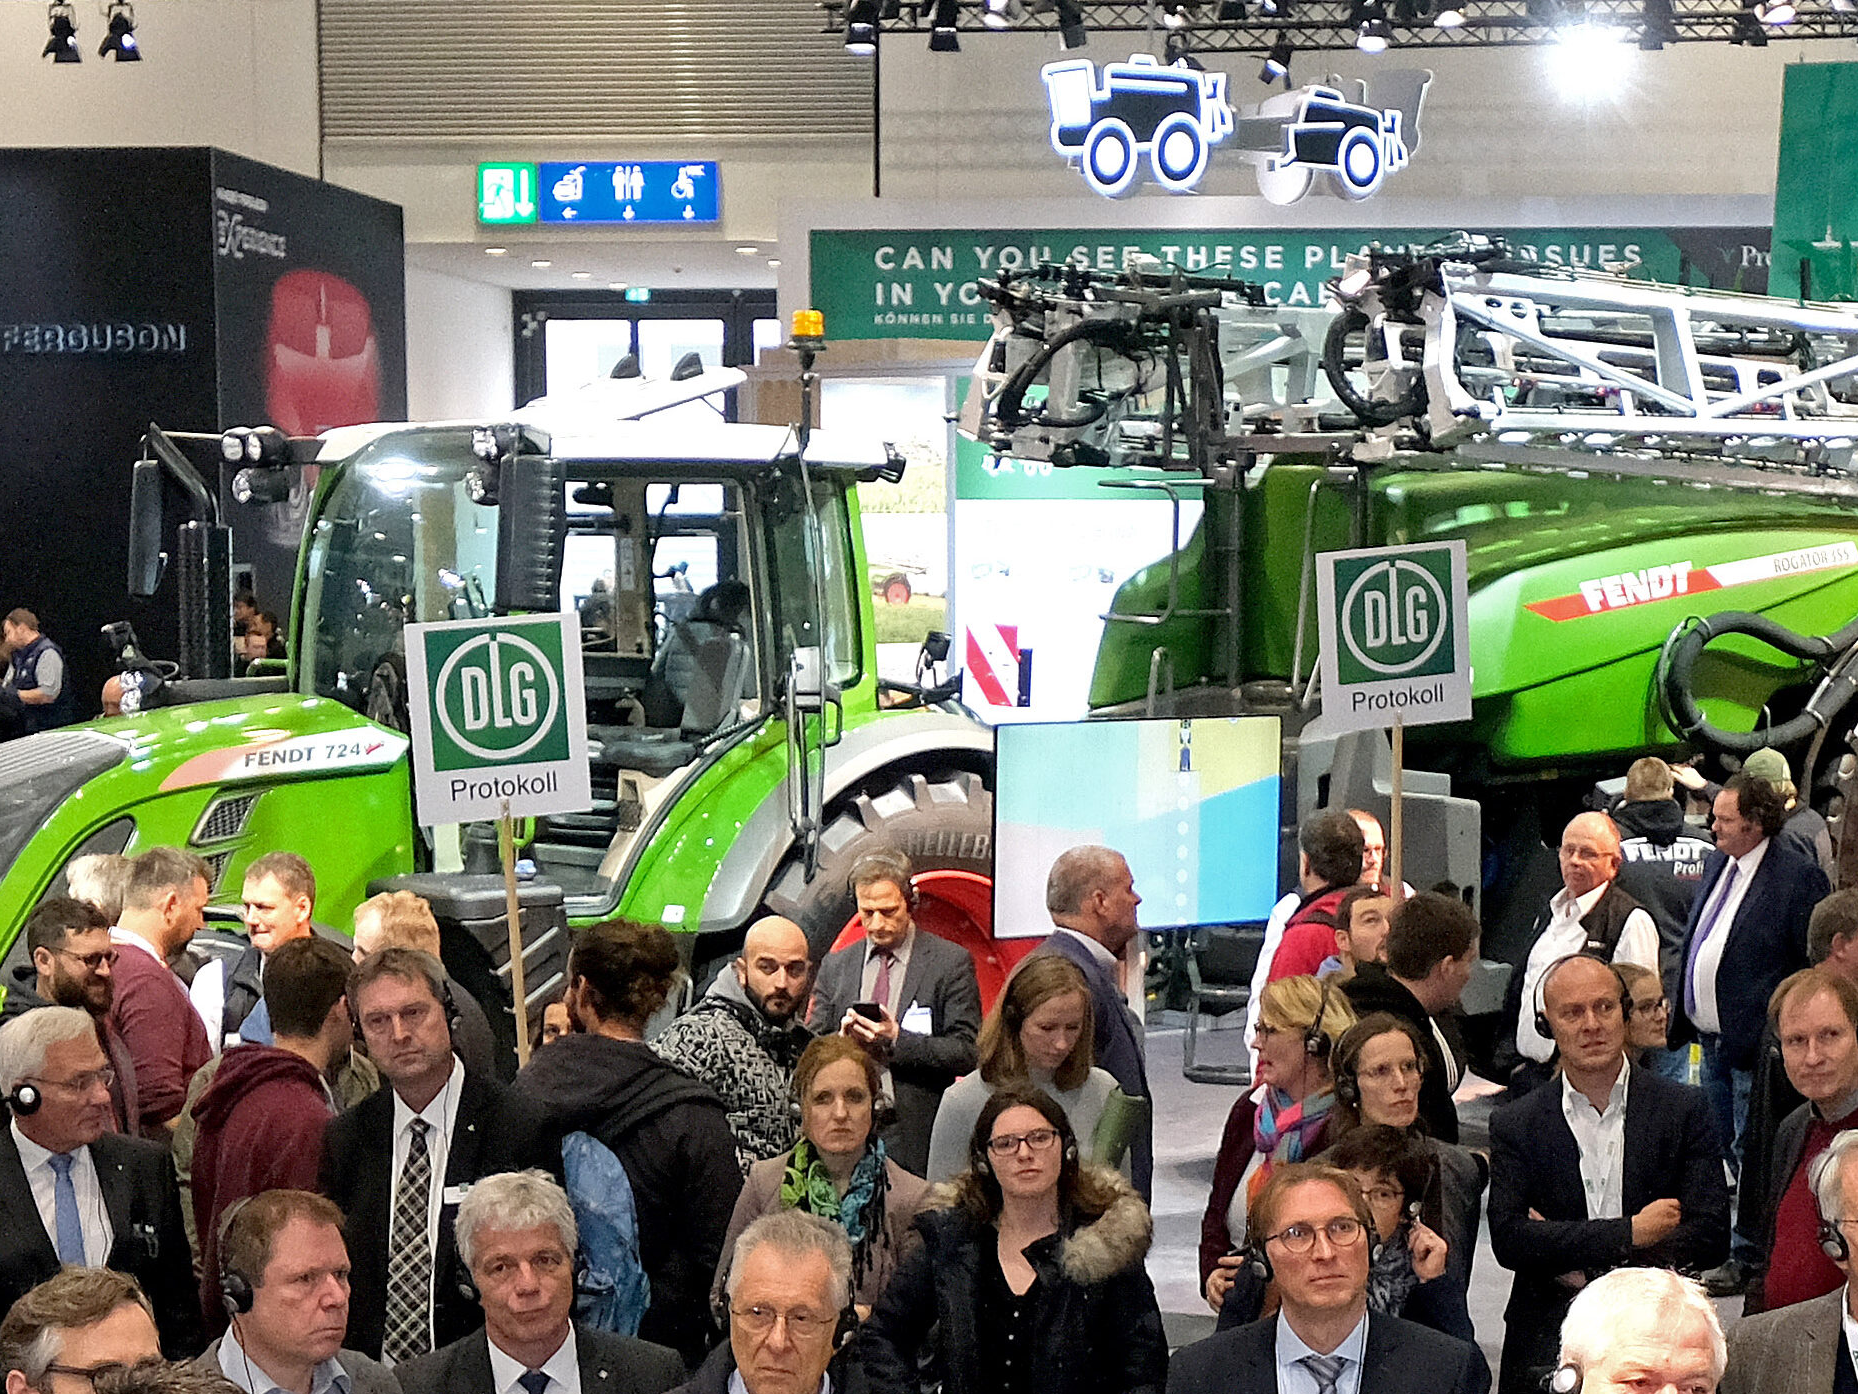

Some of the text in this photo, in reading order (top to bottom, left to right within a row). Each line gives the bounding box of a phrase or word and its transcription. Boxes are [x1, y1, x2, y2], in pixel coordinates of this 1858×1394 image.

[874, 245, 954, 271] CAN
[1161, 244, 1285, 270] THESE
[875, 281, 913, 306] IN
[950, 313, 976, 325] SIE
[3, 325, 187, 354] FERGUSON
[1579, 560, 1692, 612] FENDT
[1773, 550, 1829, 573] ROGATOR
[1363, 564, 1428, 649] DLG
[461, 638, 539, 732] DLG
[1351, 683, 1444, 713] Protokoll
[244, 742, 361, 768] FENDT 724
[450, 770, 558, 802] Protokoll
